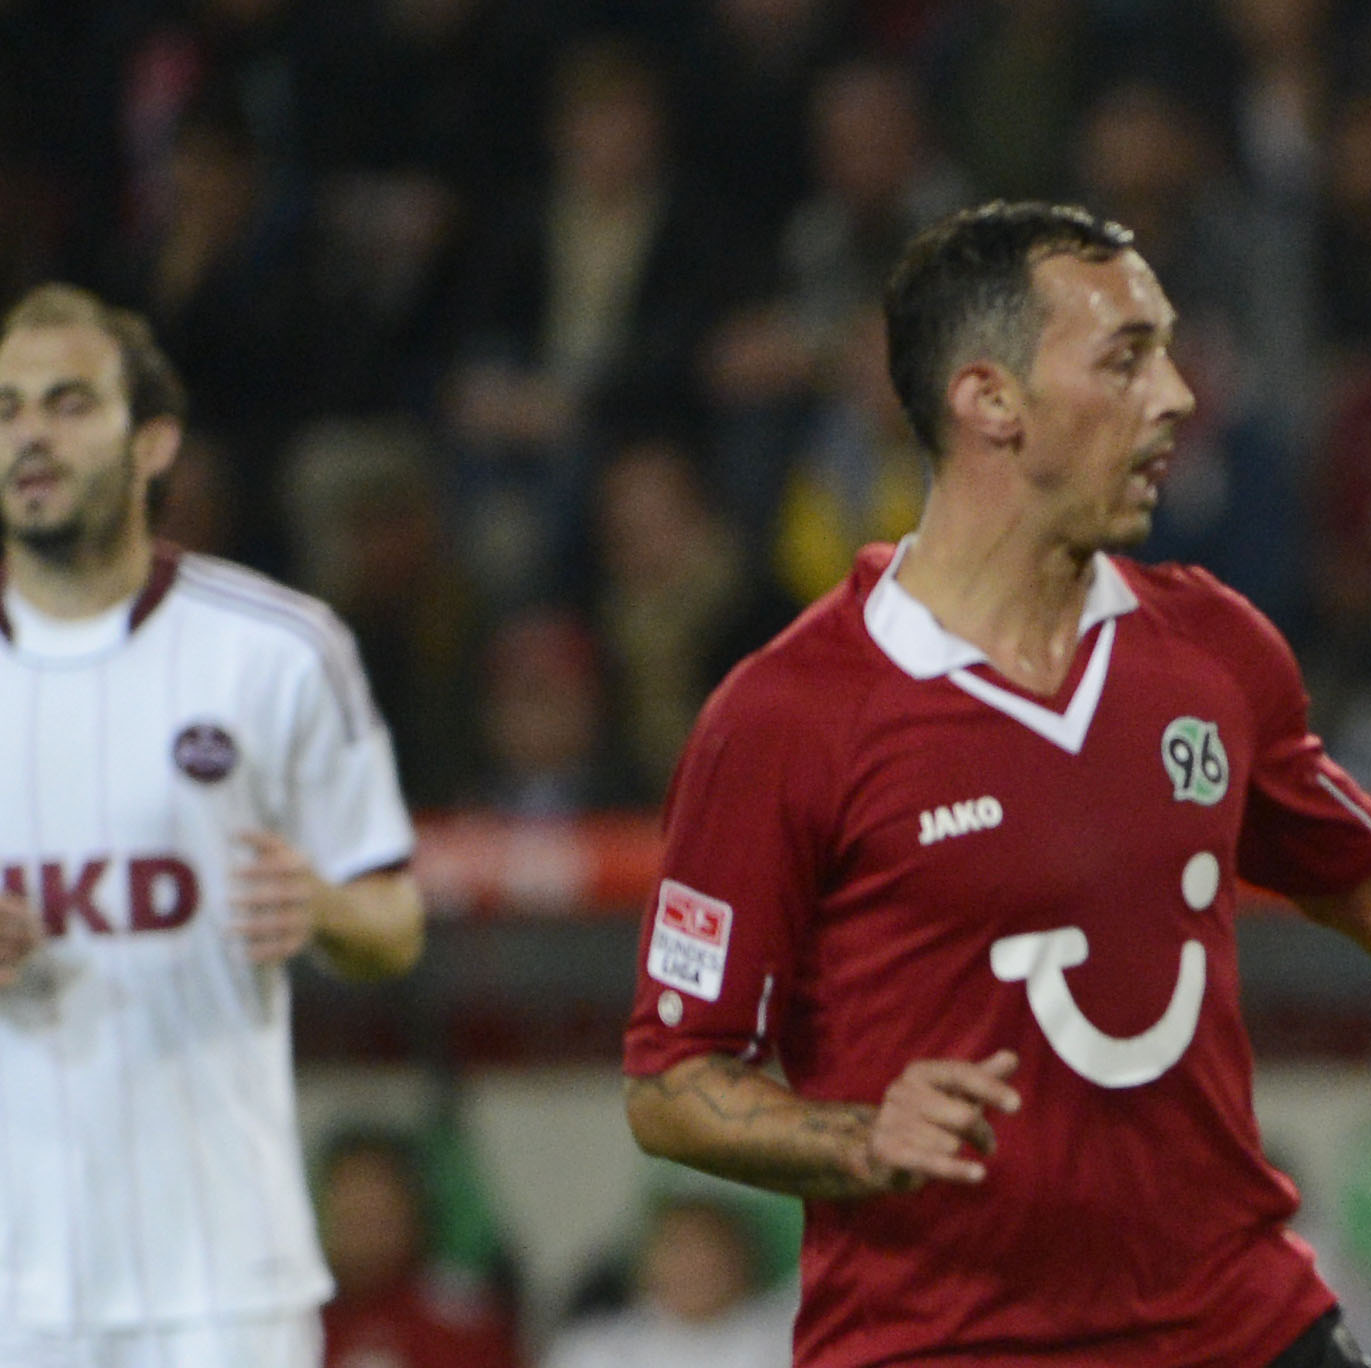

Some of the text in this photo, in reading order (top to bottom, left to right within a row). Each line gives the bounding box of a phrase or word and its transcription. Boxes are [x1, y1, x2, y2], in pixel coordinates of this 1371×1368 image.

[1169, 732, 1222, 789] 96
[918, 795, 1003, 846] JAKO
[3, 858, 201, 934] KD
